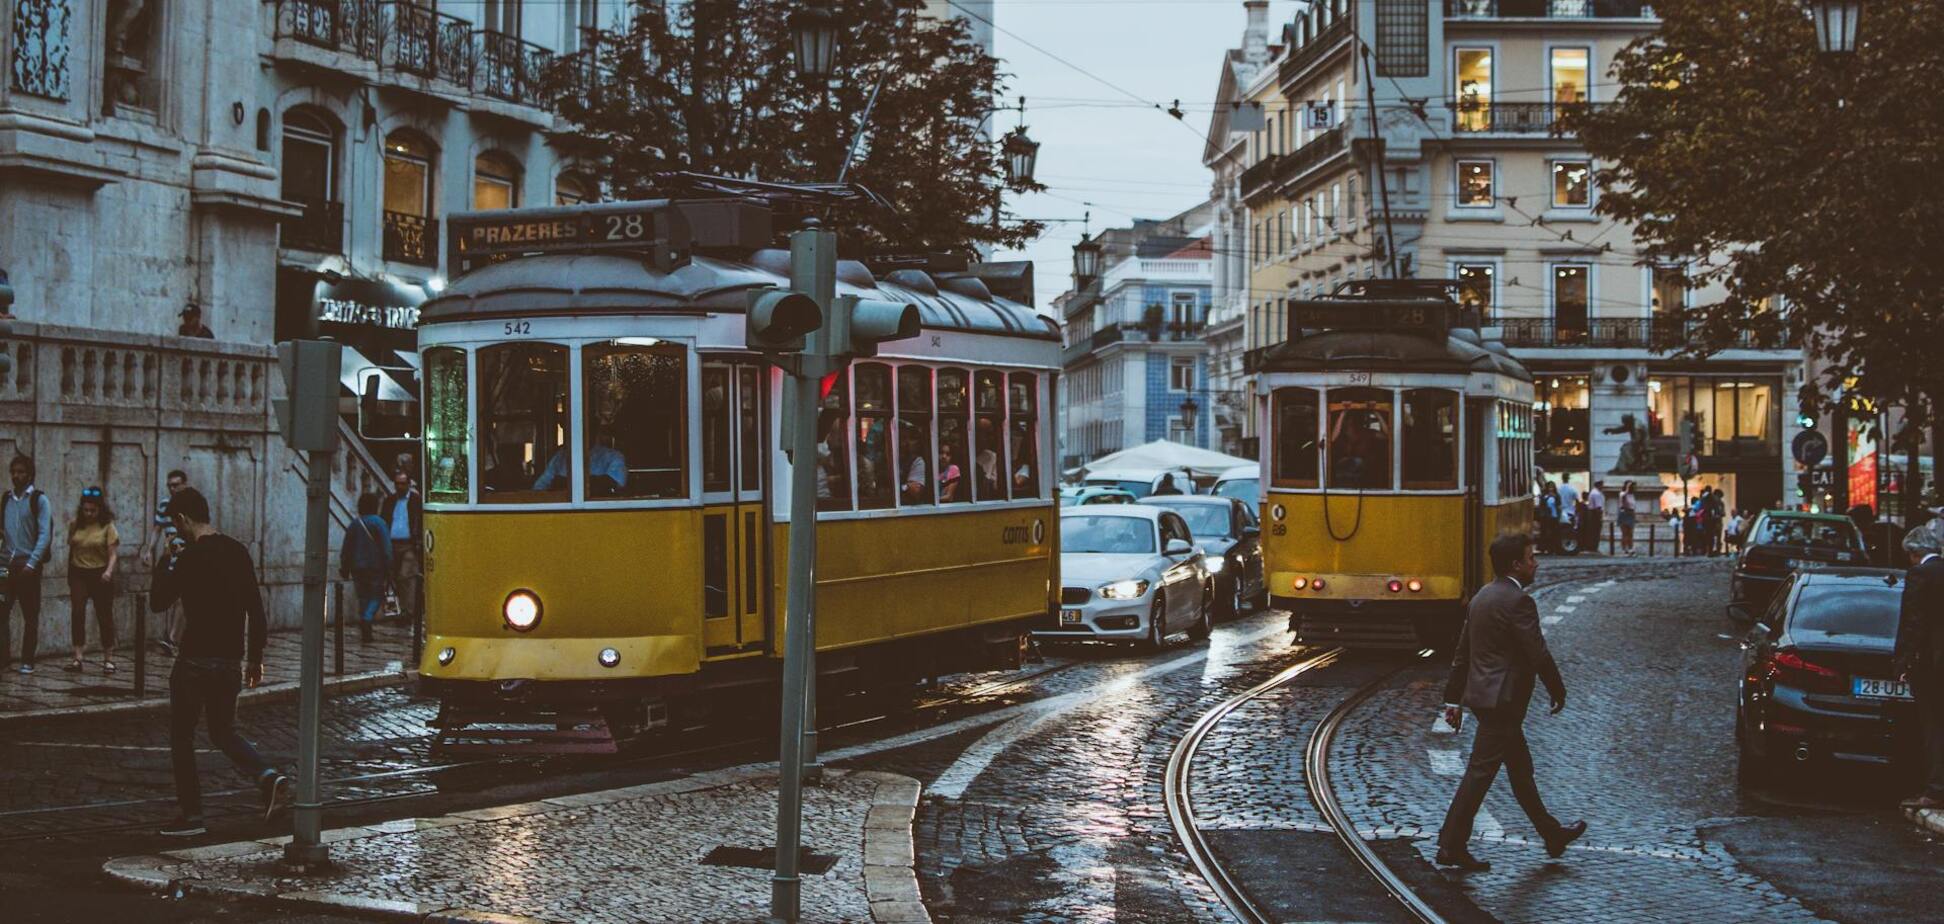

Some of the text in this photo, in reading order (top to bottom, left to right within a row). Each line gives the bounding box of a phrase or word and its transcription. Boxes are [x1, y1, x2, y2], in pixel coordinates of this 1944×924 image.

[1314, 109, 1328, 121] 15
[473, 214, 644, 243] PRAZERES 28
[505, 321, 530, 335] 542
[1350, 373, 1367, 383] 549
[1862, 681, 1912, 695] 28-UD-
